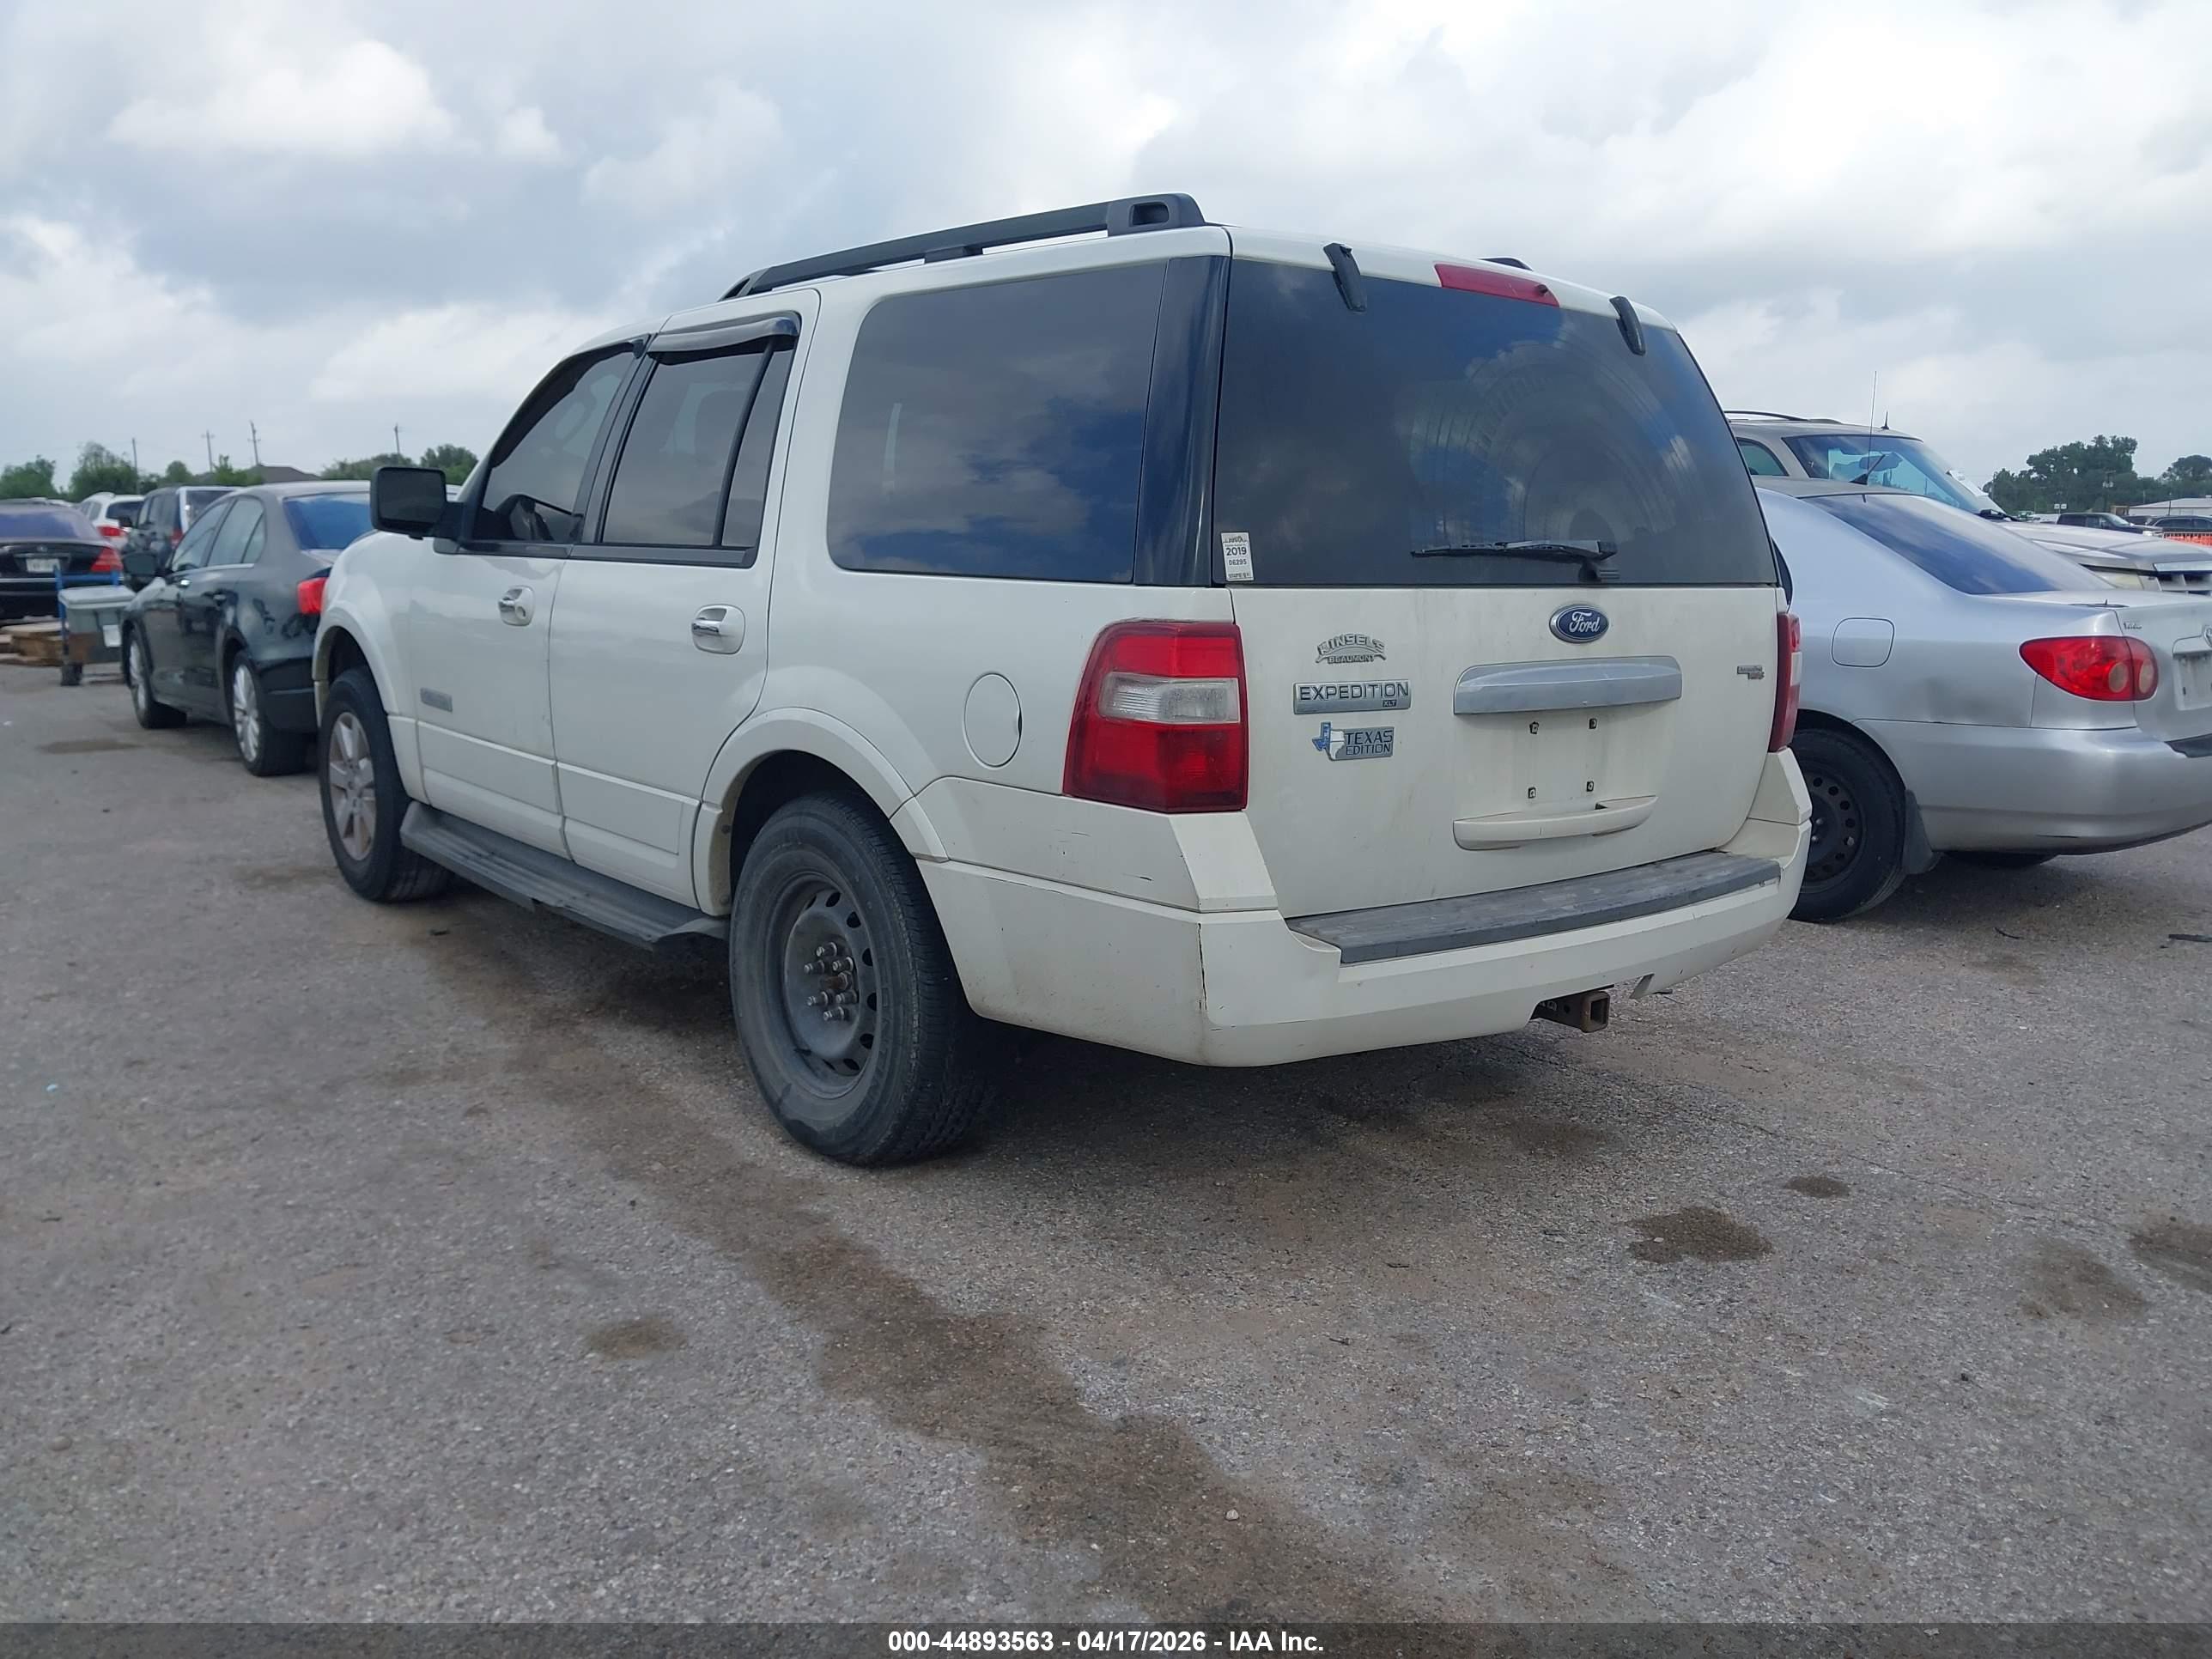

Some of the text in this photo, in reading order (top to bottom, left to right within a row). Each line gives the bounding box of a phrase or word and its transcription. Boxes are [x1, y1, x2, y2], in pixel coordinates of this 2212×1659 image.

[1225, 547, 1247, 556] 2019
[1569, 611, 1601, 633] Ford
[1328, 654, 1375, 665] BEAUMONT
[1299, 682, 1409, 702] EXPEDITION
[1346, 730, 1394, 745] TEXAS
[1346, 744, 1392, 756] EDITION
